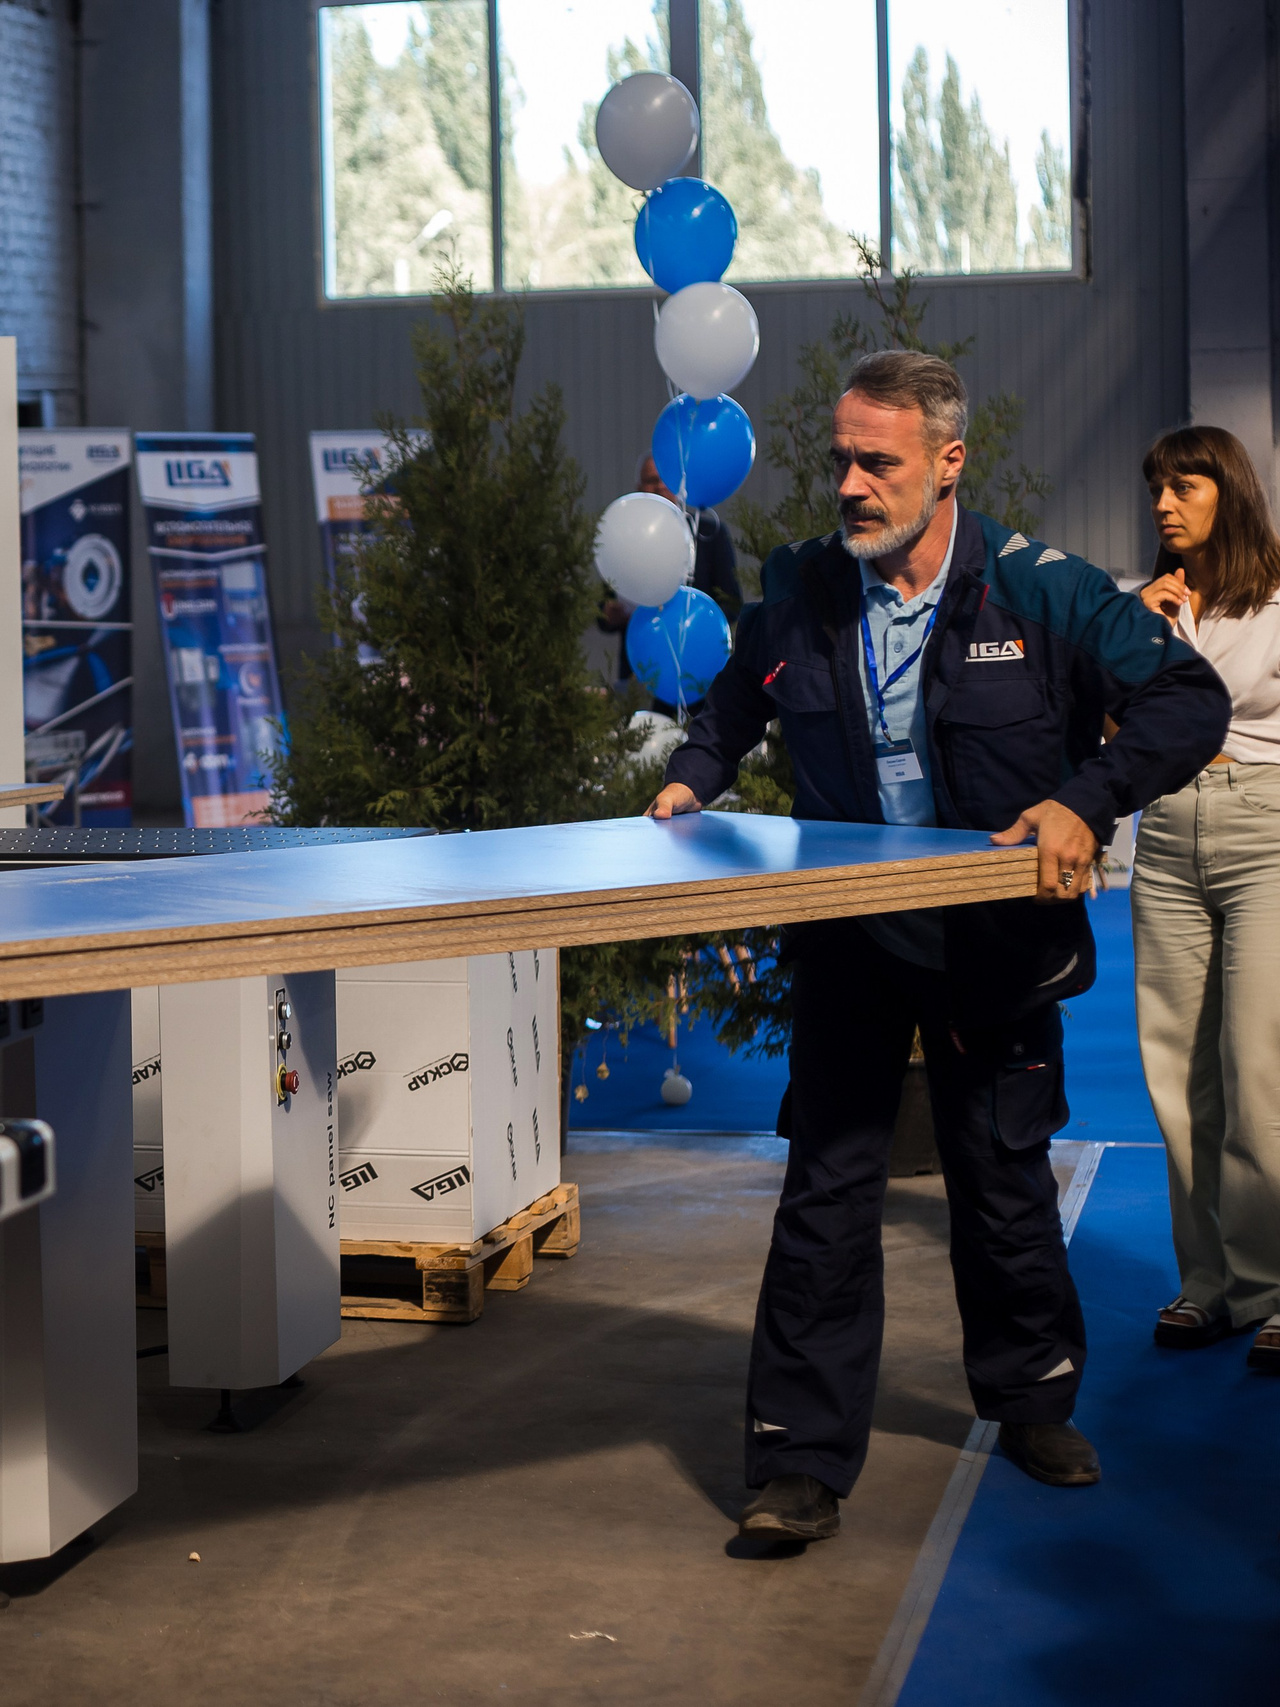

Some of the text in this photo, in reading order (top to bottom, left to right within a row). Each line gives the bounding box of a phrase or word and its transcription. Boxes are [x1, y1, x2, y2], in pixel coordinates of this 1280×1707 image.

[965, 639, 1025, 663] IGA
[327, 1124, 335, 1187] panel
[339, 1161, 379, 1192] LIG
[328, 1194, 335, 1230] NC
